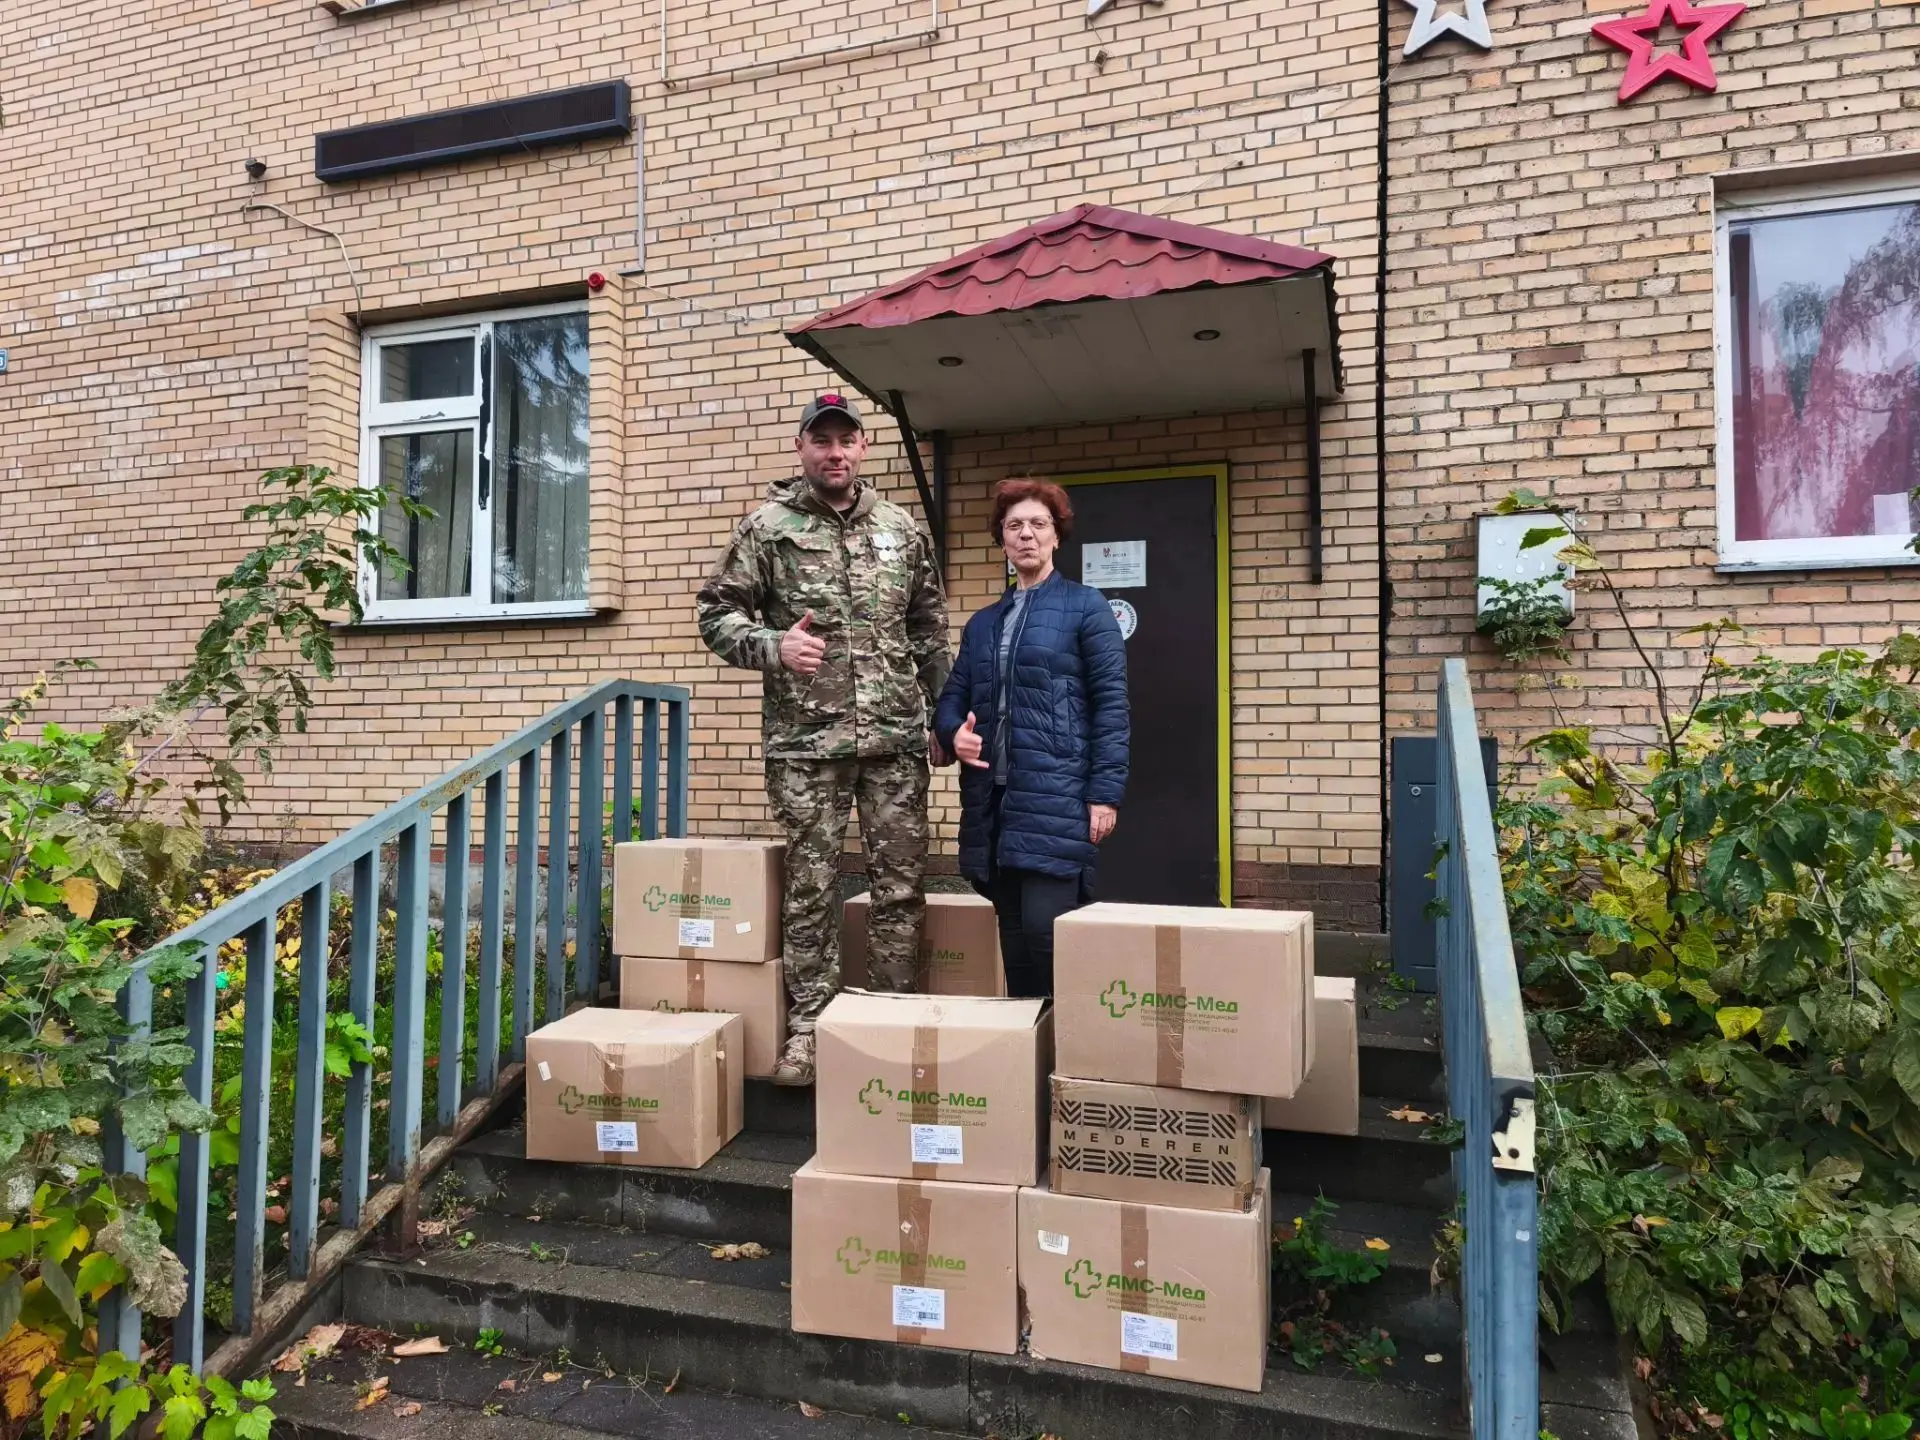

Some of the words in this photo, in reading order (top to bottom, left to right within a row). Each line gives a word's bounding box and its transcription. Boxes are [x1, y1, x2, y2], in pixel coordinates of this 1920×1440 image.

[669, 893, 731, 906] АМС-Мед
[1140, 992, 1239, 1013] АМС-Мед
[587, 1094, 659, 1108] АМС-Мед
[1064, 1130, 1229, 1155] MEDEREN
[1106, 1273, 1206, 1301] АМС-Мед
